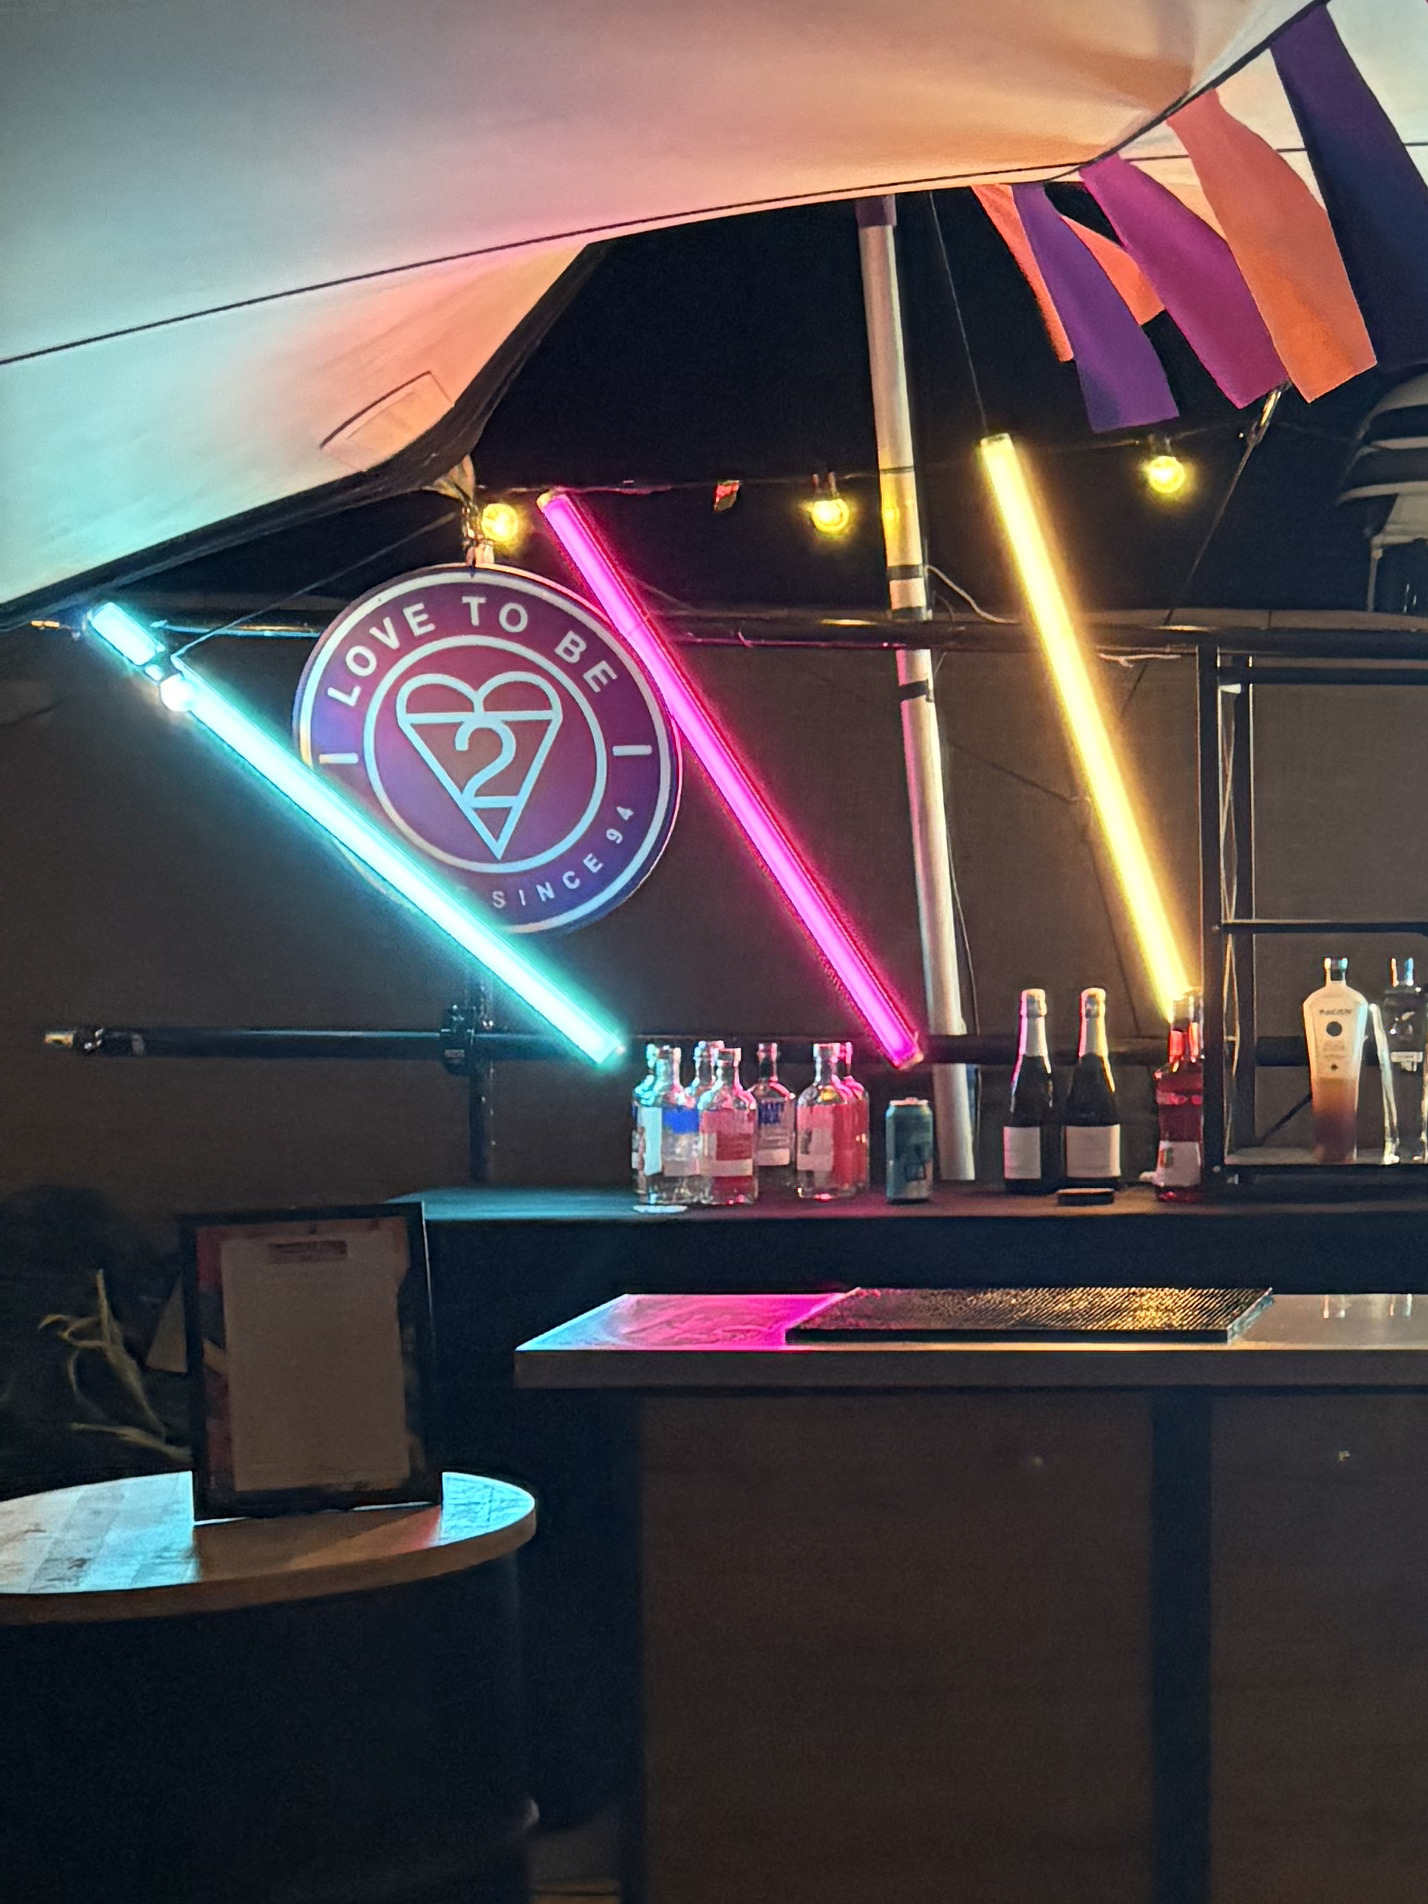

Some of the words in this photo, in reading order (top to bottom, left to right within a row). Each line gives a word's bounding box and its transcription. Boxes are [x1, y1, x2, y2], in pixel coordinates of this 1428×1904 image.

[328, 602, 436, 707] LOVE
[462, 596, 529, 633] TO
[554, 630, 618, 693] BE
[492, 852, 604, 909] SINCE
[605, 805, 635, 845] 94
